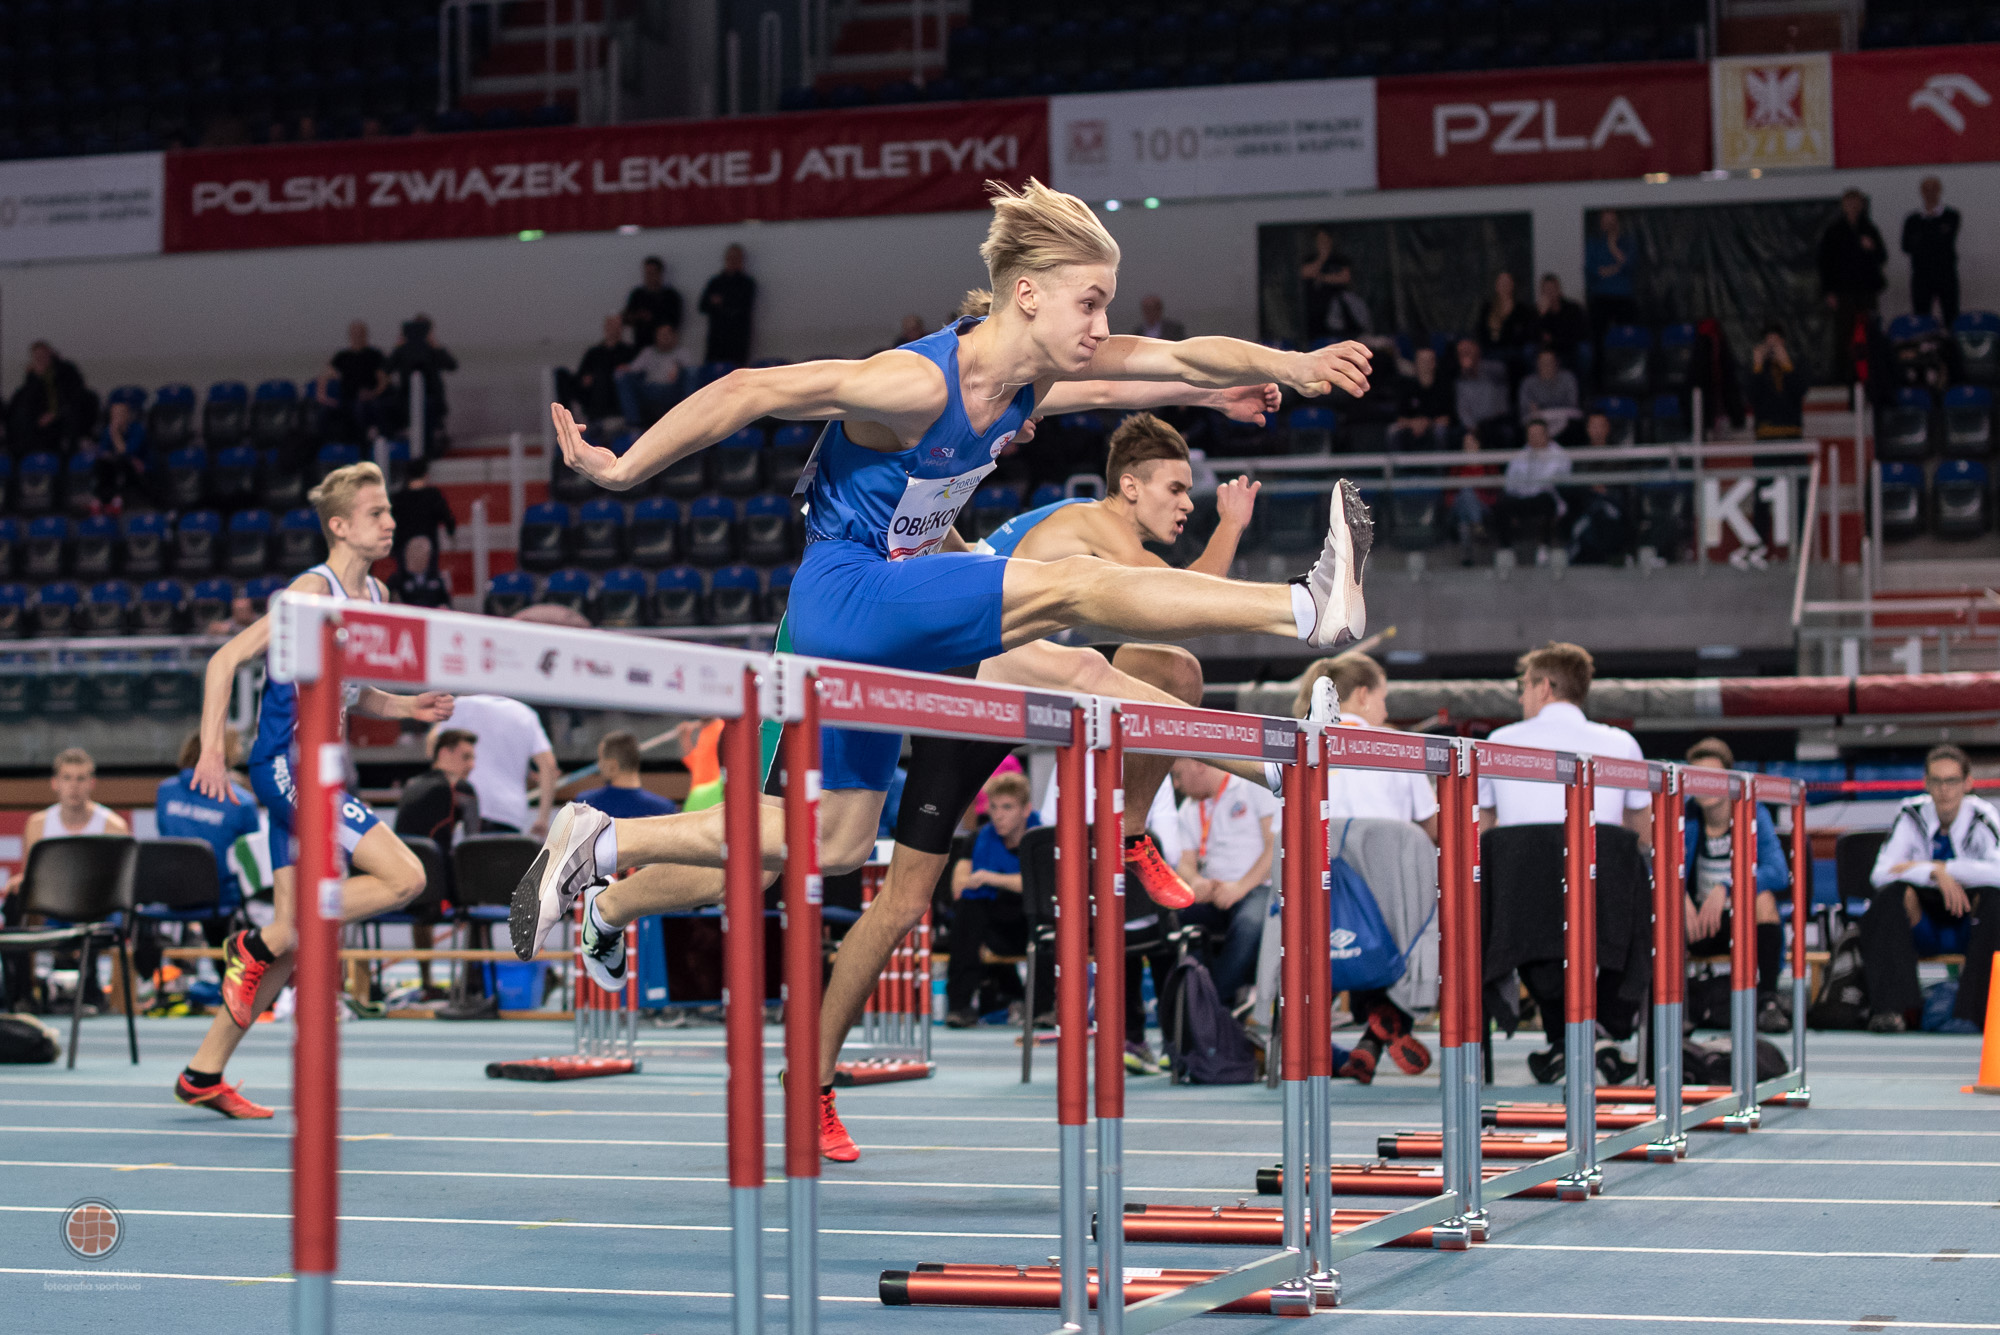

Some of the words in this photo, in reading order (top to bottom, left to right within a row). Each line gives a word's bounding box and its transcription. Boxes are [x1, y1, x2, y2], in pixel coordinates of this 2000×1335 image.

[1433, 96, 1653, 157] PZLA
[192, 174, 356, 217] POLSKI
[365, 161, 584, 208] ZWIĄZEK
[593, 149, 782, 194] LEKKIEJ
[795, 136, 1019, 183] ATLETYKI
[1703, 475, 1790, 546] K1
[820, 676, 864, 710] PZLA
[987, 700, 1021, 723] POLSKI
[1122, 713, 1152, 738] PZLA
[1154, 718, 1185, 736] HALOWE
[1235, 725, 1260, 743] POLSKI
